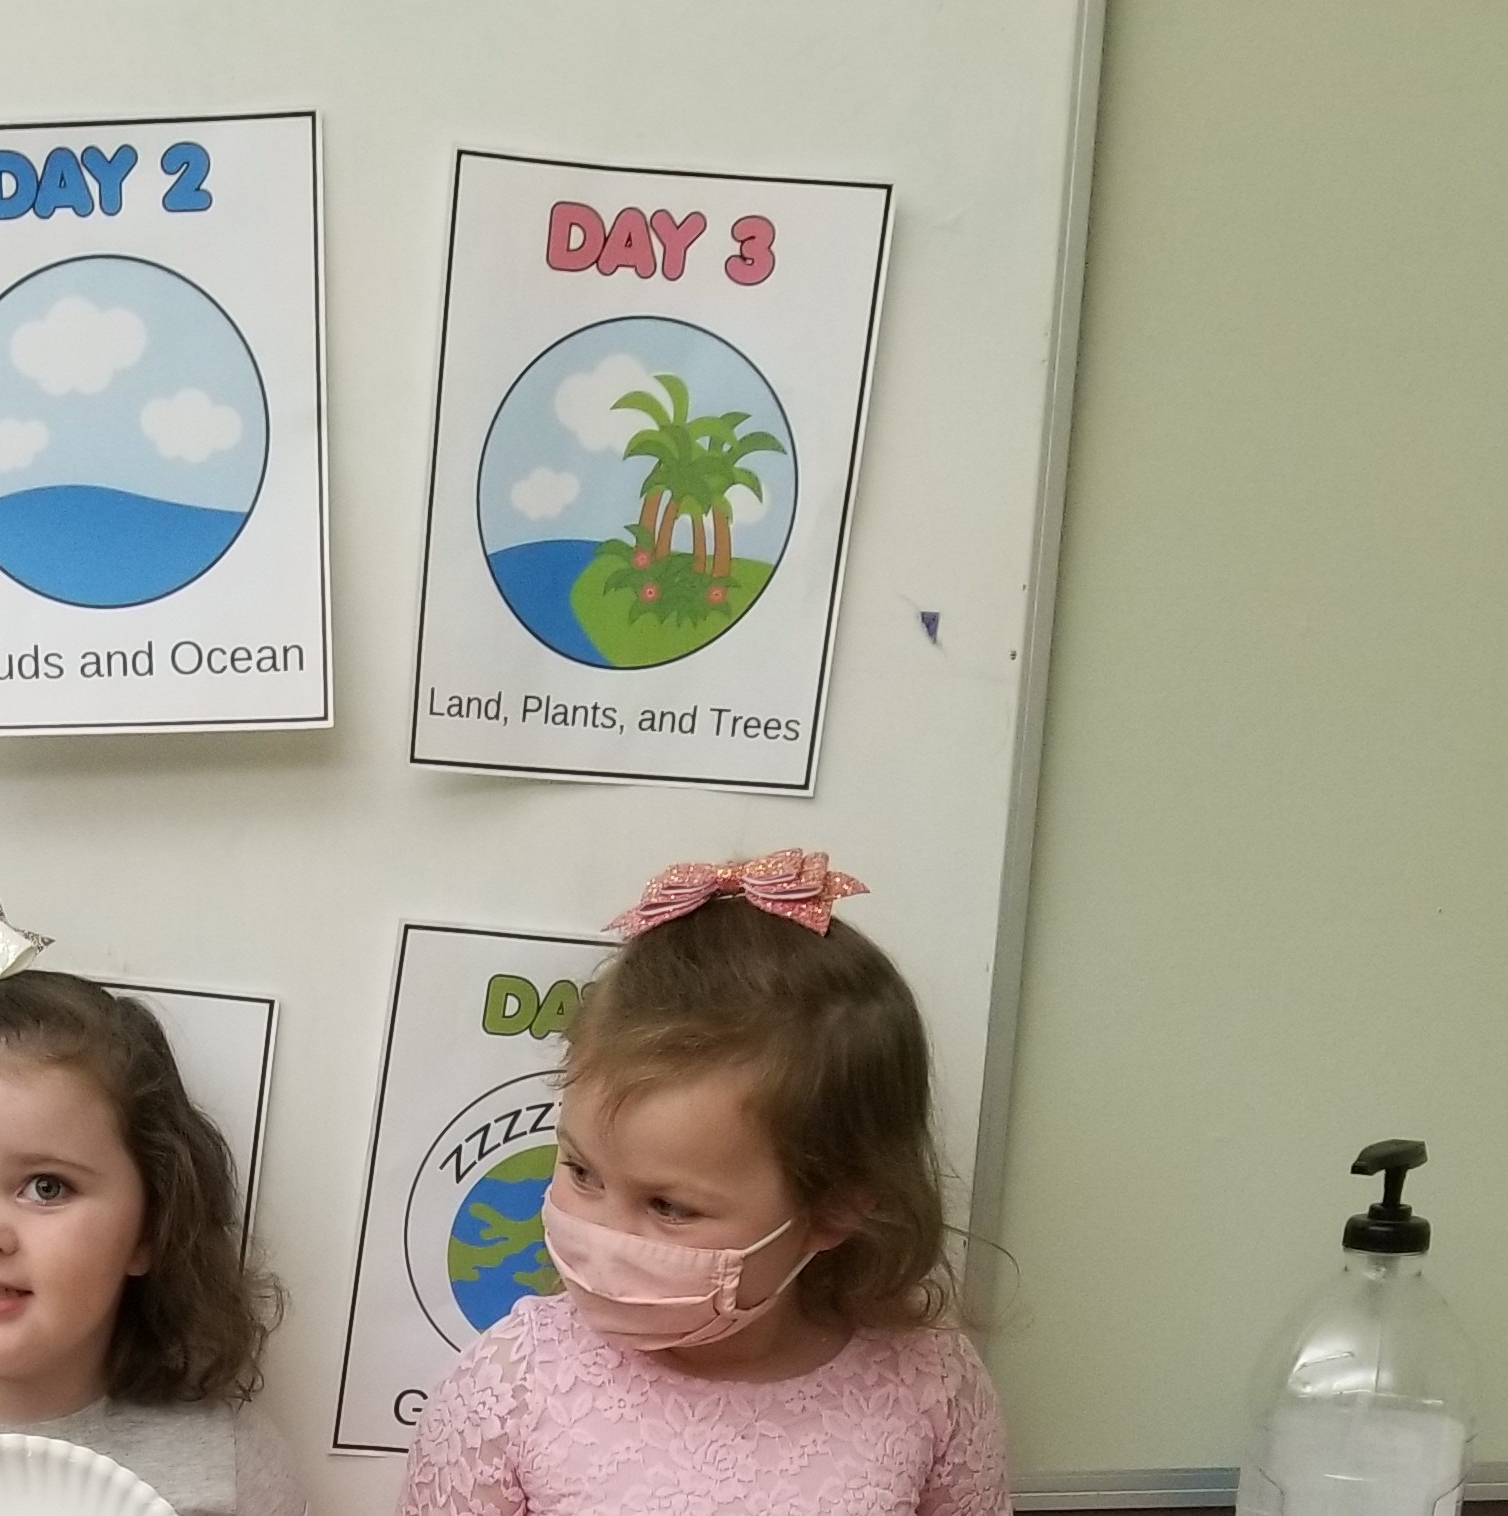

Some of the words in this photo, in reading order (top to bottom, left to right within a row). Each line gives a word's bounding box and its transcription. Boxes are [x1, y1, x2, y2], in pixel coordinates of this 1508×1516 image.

[160, 141, 213, 213] 2
[546, 201, 707, 281] DAY
[724, 215, 776, 286] 3
[80, 641, 153, 678] and
[171, 641, 303, 675] Ocean
[430, 687, 508, 726] Land,
[522, 695, 624, 734] Plants,
[638, 705, 697, 734] and
[710, 708, 800, 741] Trees
